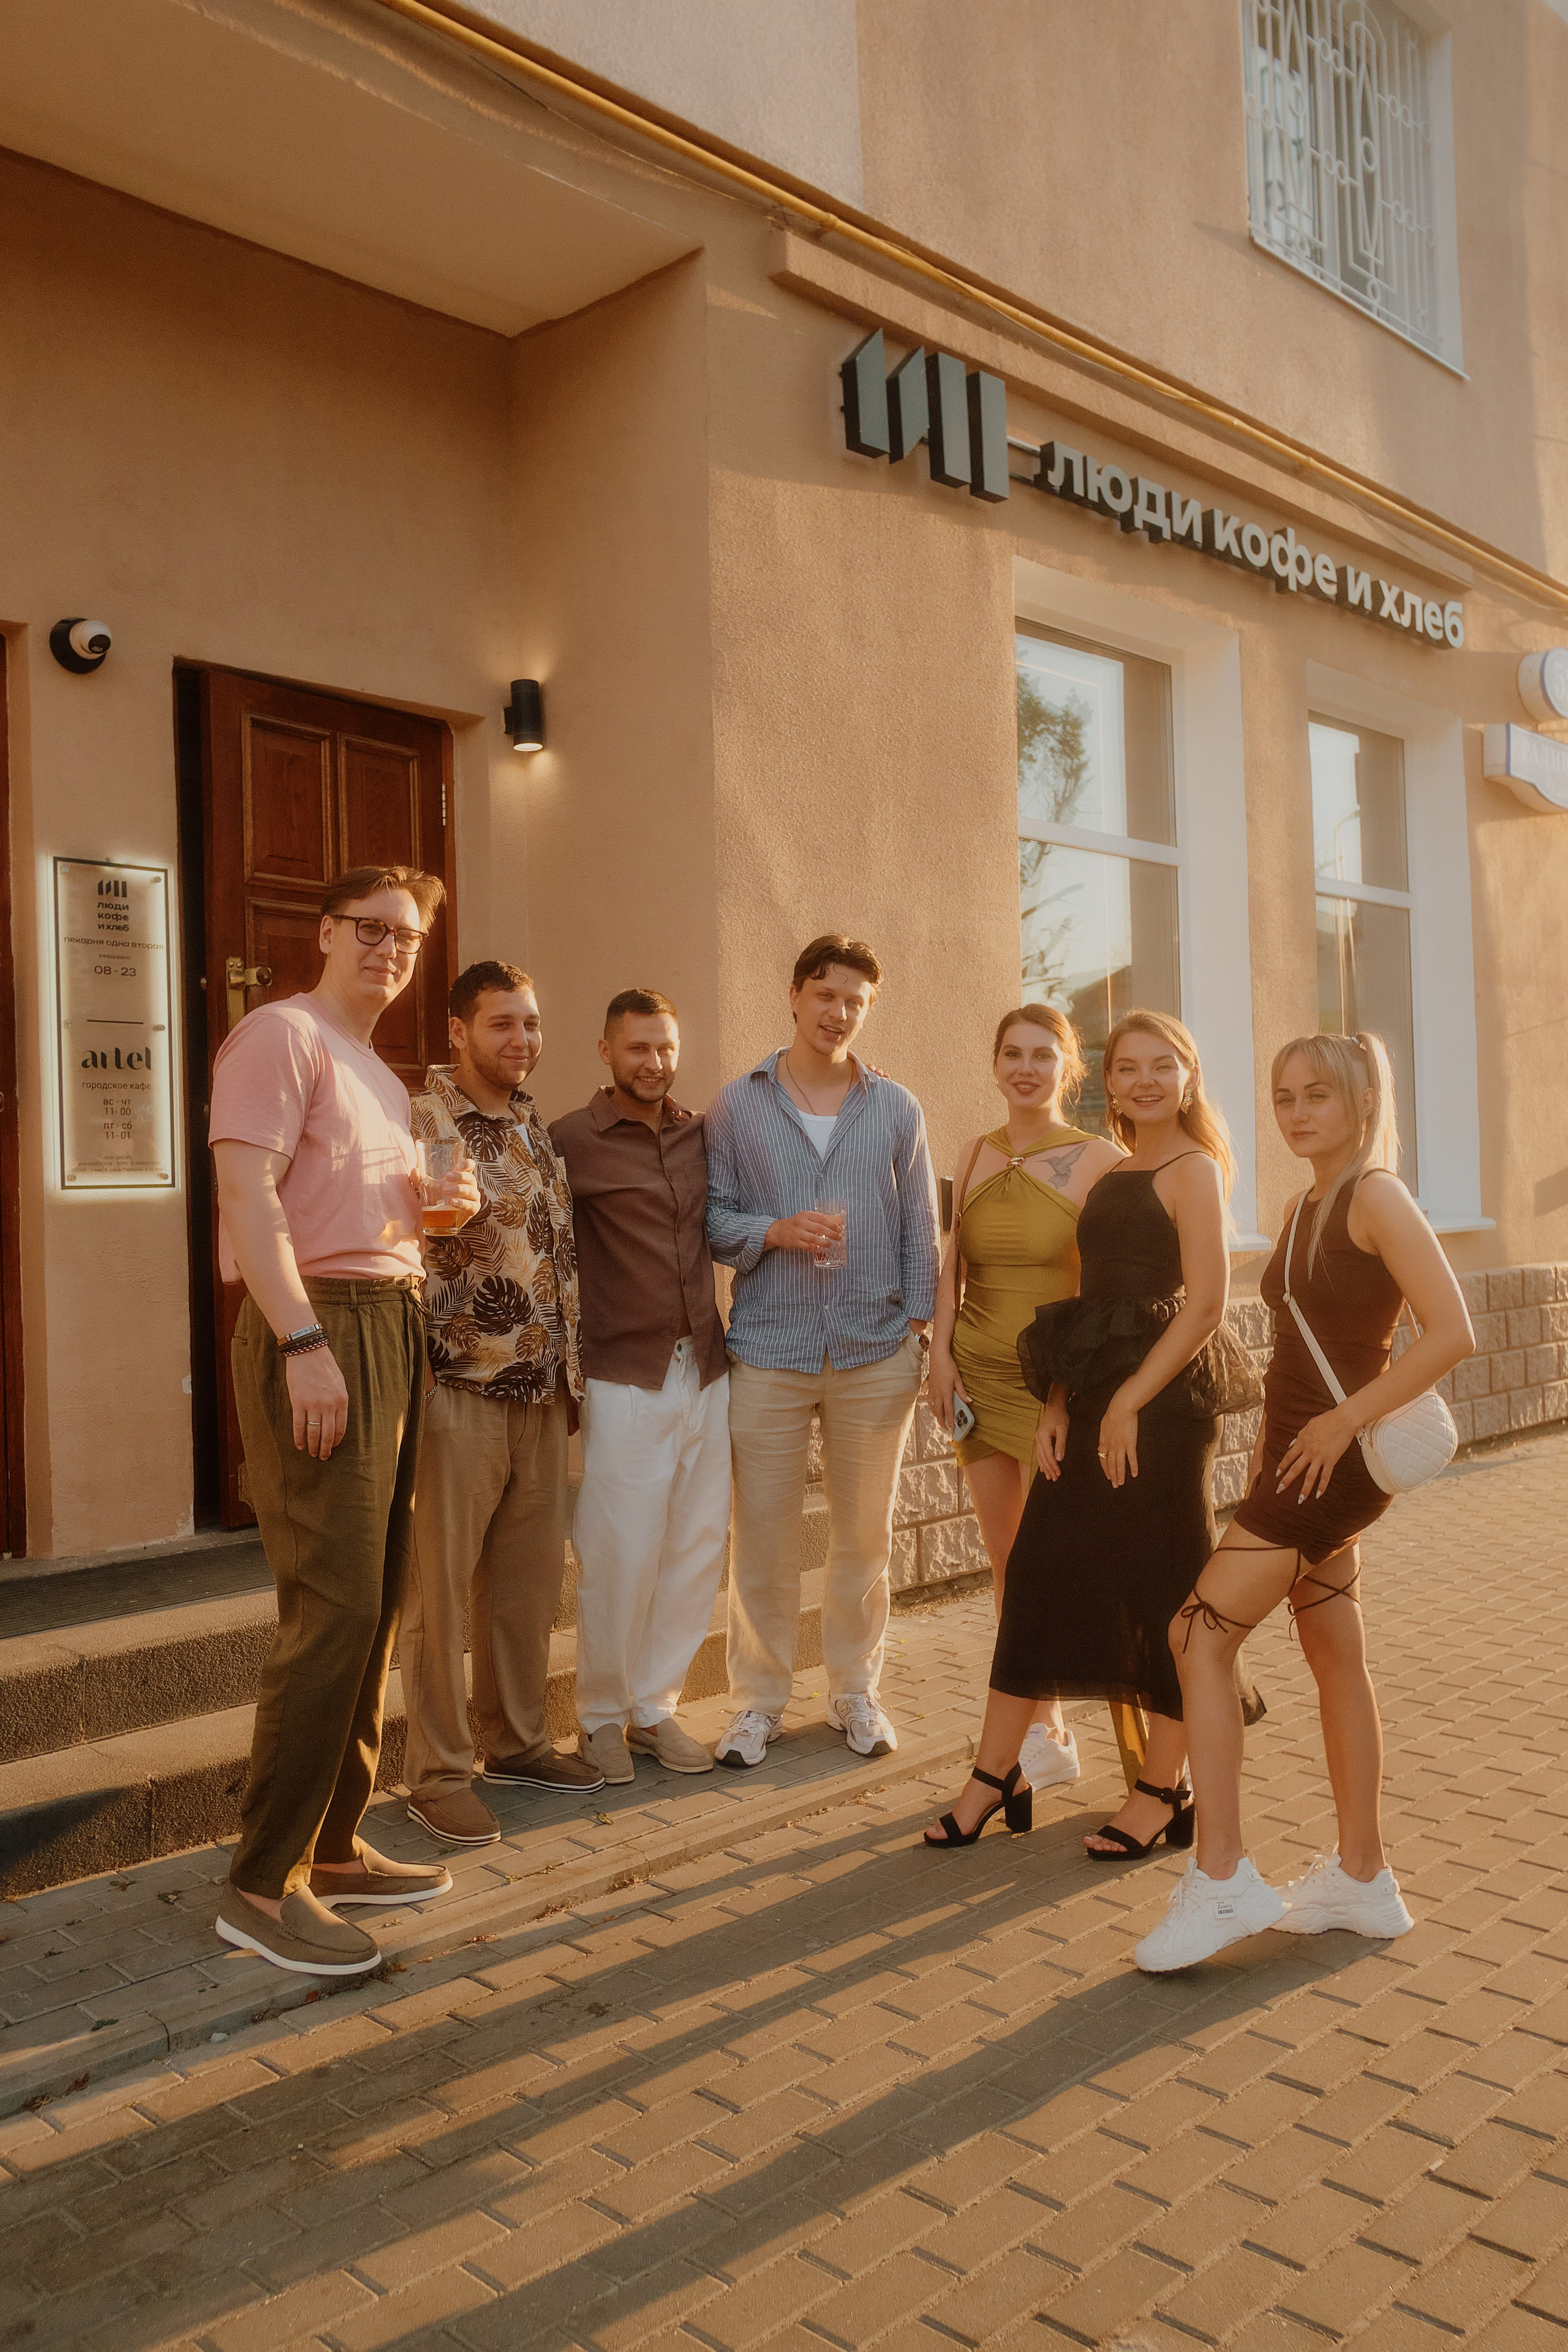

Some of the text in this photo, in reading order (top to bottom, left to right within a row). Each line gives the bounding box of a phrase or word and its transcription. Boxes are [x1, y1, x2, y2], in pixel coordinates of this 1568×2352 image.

[1047, 440, 1464, 649] люди кофе и хлеб
[97, 902, 129, 911] люди
[98, 913, 129, 922] кофе
[64, 936, 104, 946] пекарня
[94, 965, 111, 975] 08
[121, 967, 136, 976] 23
[81, 1047, 151, 1071] artel
[82, 1082, 151, 1090] городское кафе
[122, 1121, 132, 1129] сб
